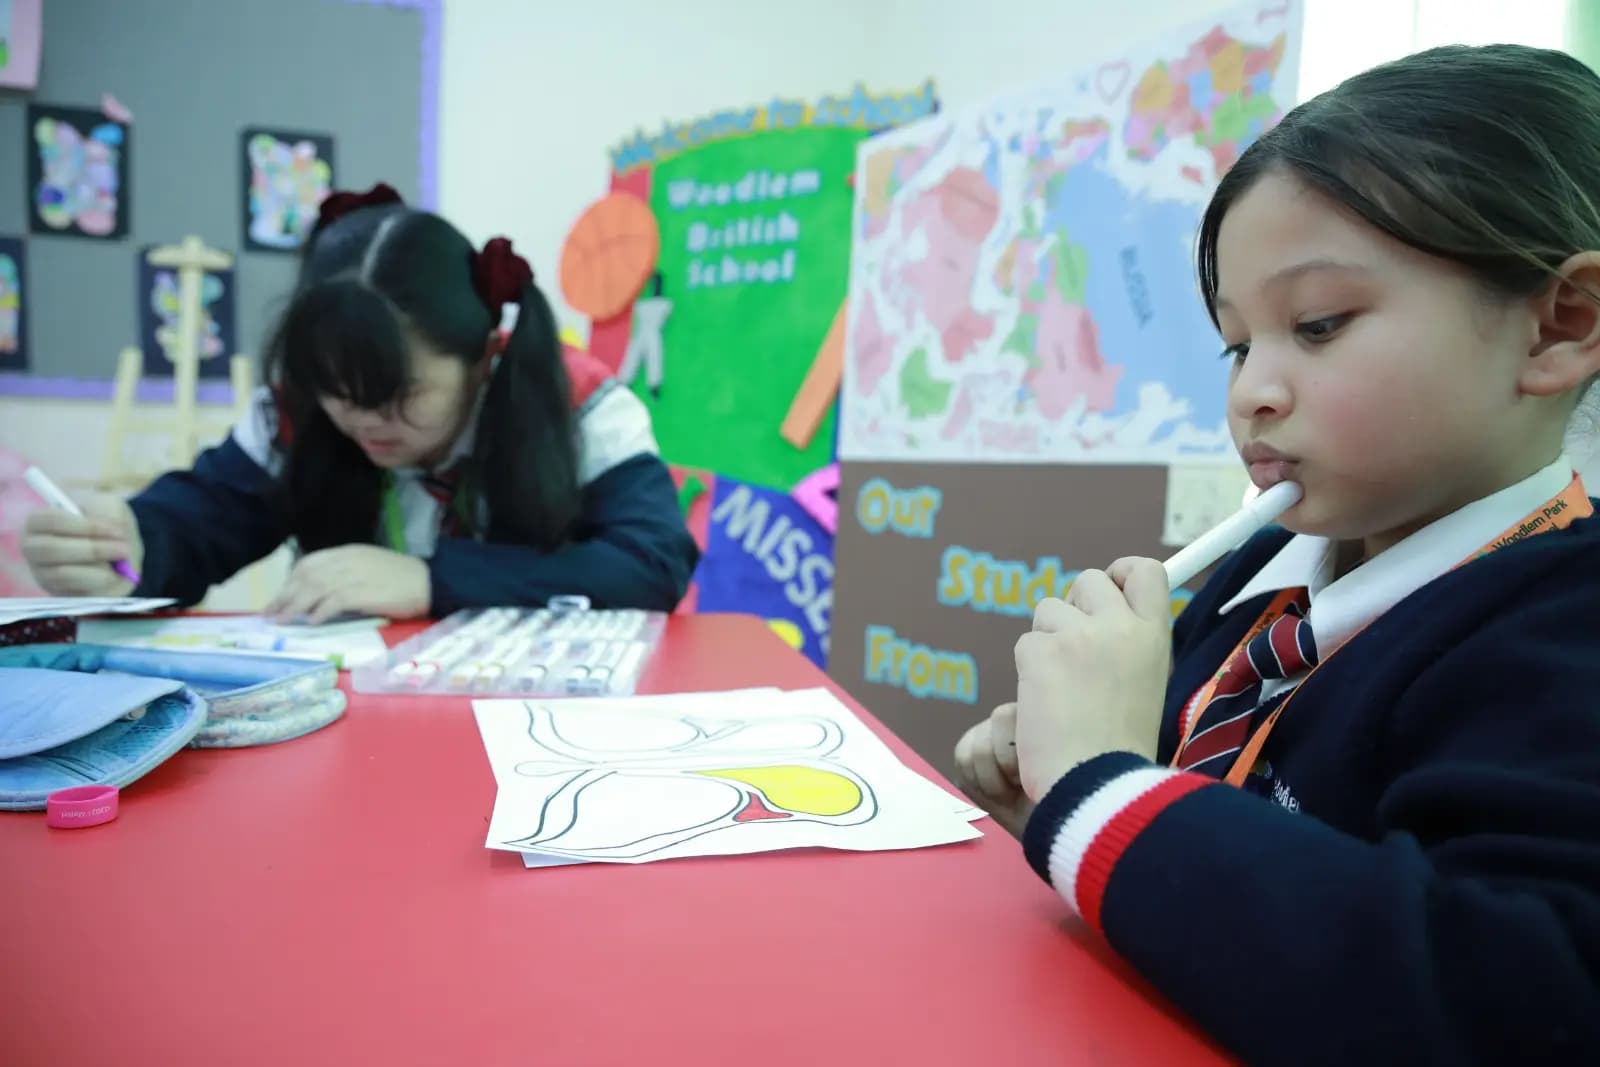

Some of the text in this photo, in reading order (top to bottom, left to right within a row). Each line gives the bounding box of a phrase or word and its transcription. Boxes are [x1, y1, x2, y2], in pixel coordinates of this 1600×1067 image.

[667, 169, 821, 210] Woodlem
[687, 211, 800, 253] British
[687, 249, 796, 289] School
[856, 477, 943, 539] Our
[1542, 499, 1568, 520] Park
[711, 485, 835, 653] MISSE
[864, 624, 979, 705] From
